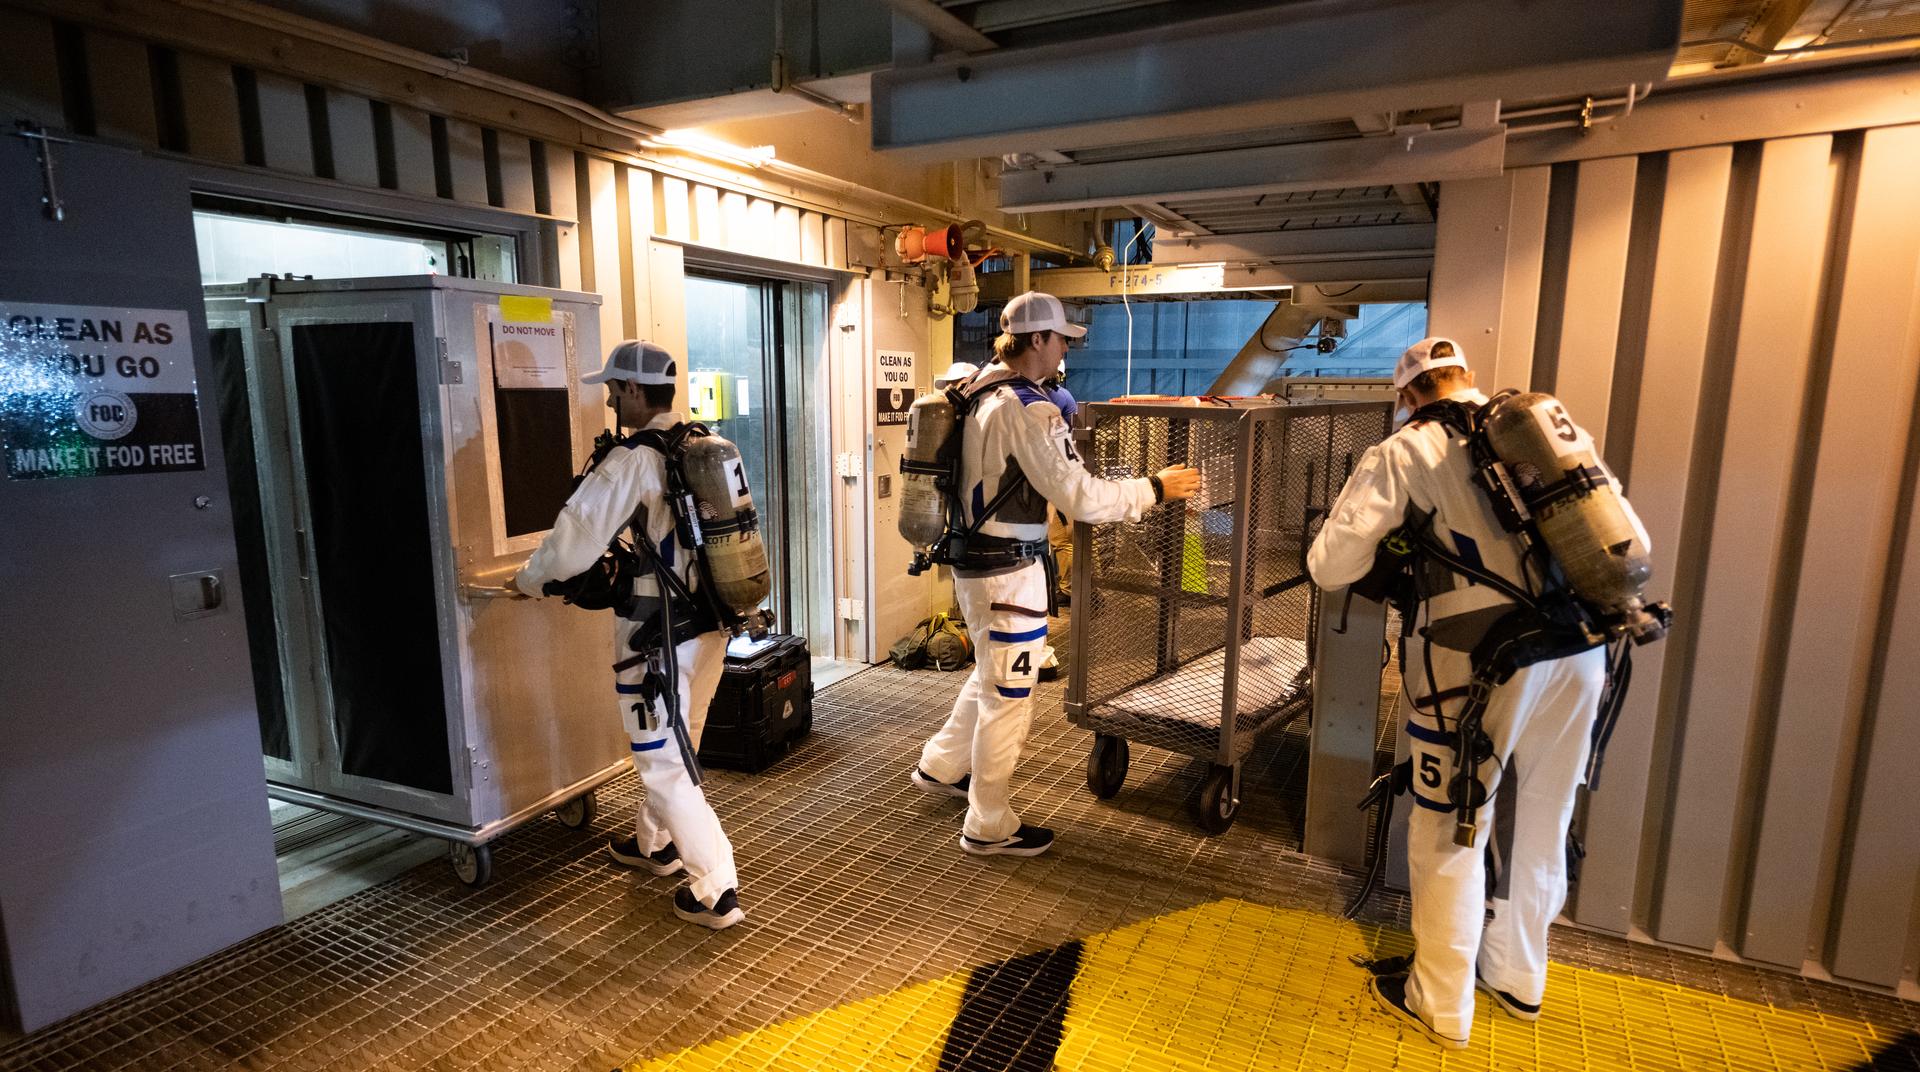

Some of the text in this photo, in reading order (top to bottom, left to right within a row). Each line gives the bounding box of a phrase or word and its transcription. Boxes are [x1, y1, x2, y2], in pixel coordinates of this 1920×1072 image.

[9, 315, 173, 345] CLEAN AS
[502, 325, 556, 336] DO NOT MOVE
[116, 356, 160, 378] GO
[880, 355, 911, 367] CLEAN AS
[884, 371, 908, 382] YOU GO
[878, 412, 891, 422] MAKE
[891, 412, 895, 422] IT
[1545, 405, 1577, 442] 5
[16, 444, 197, 471] MAKE IT FOD FREE
[1064, 438, 1079, 462] 4
[734, 462, 749, 497] 1
[1011, 651, 1032, 676] 4
[631, 702, 647, 730] 1
[1420, 752, 1442, 789] 5
